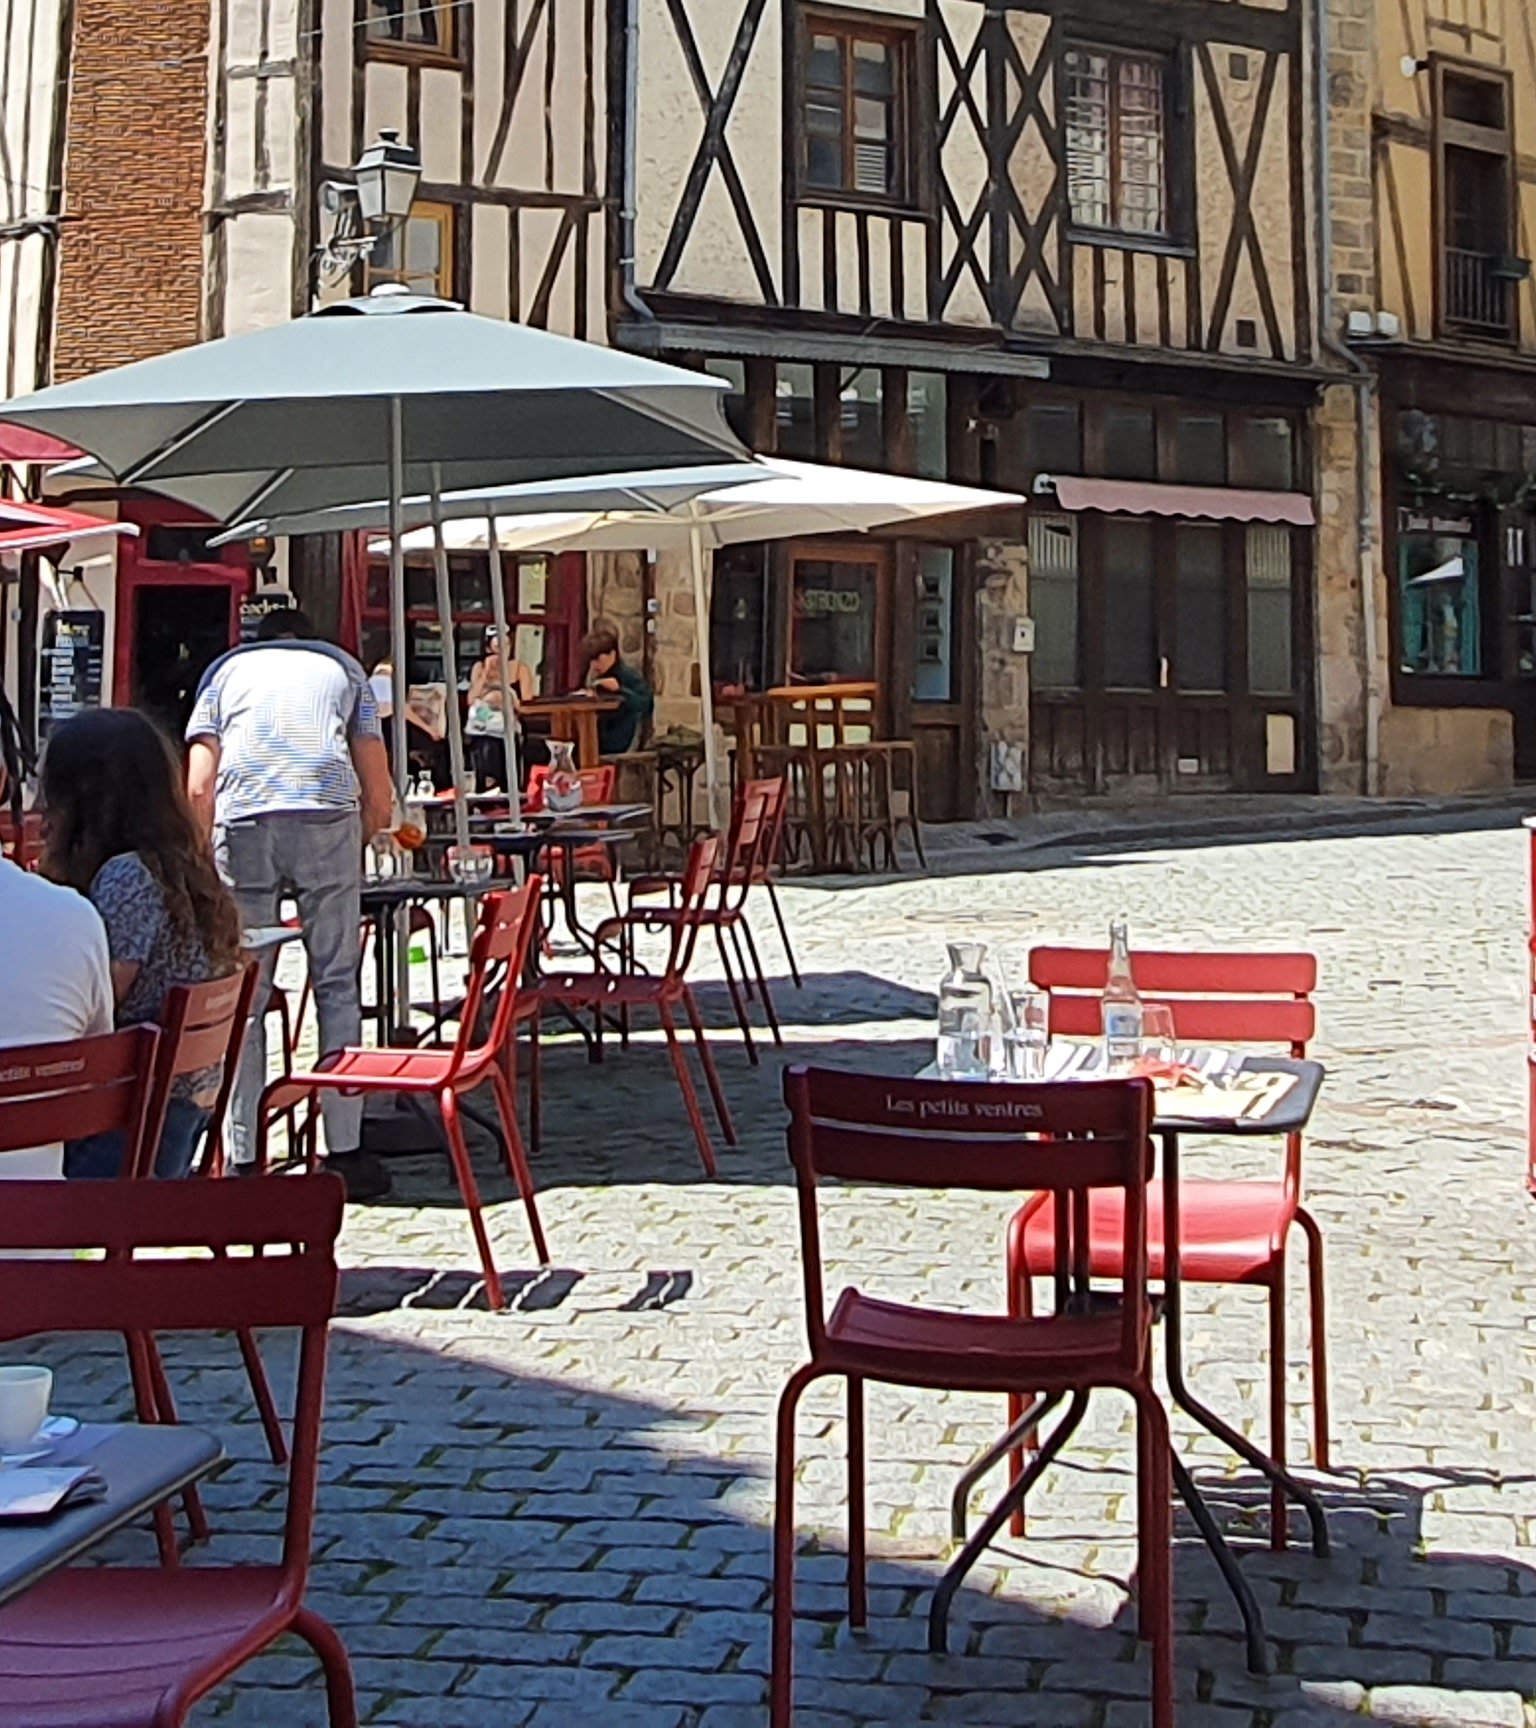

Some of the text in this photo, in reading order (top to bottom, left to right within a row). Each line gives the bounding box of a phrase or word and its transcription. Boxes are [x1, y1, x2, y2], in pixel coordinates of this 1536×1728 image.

[886, 1094, 1044, 1119] Les petits ventres
